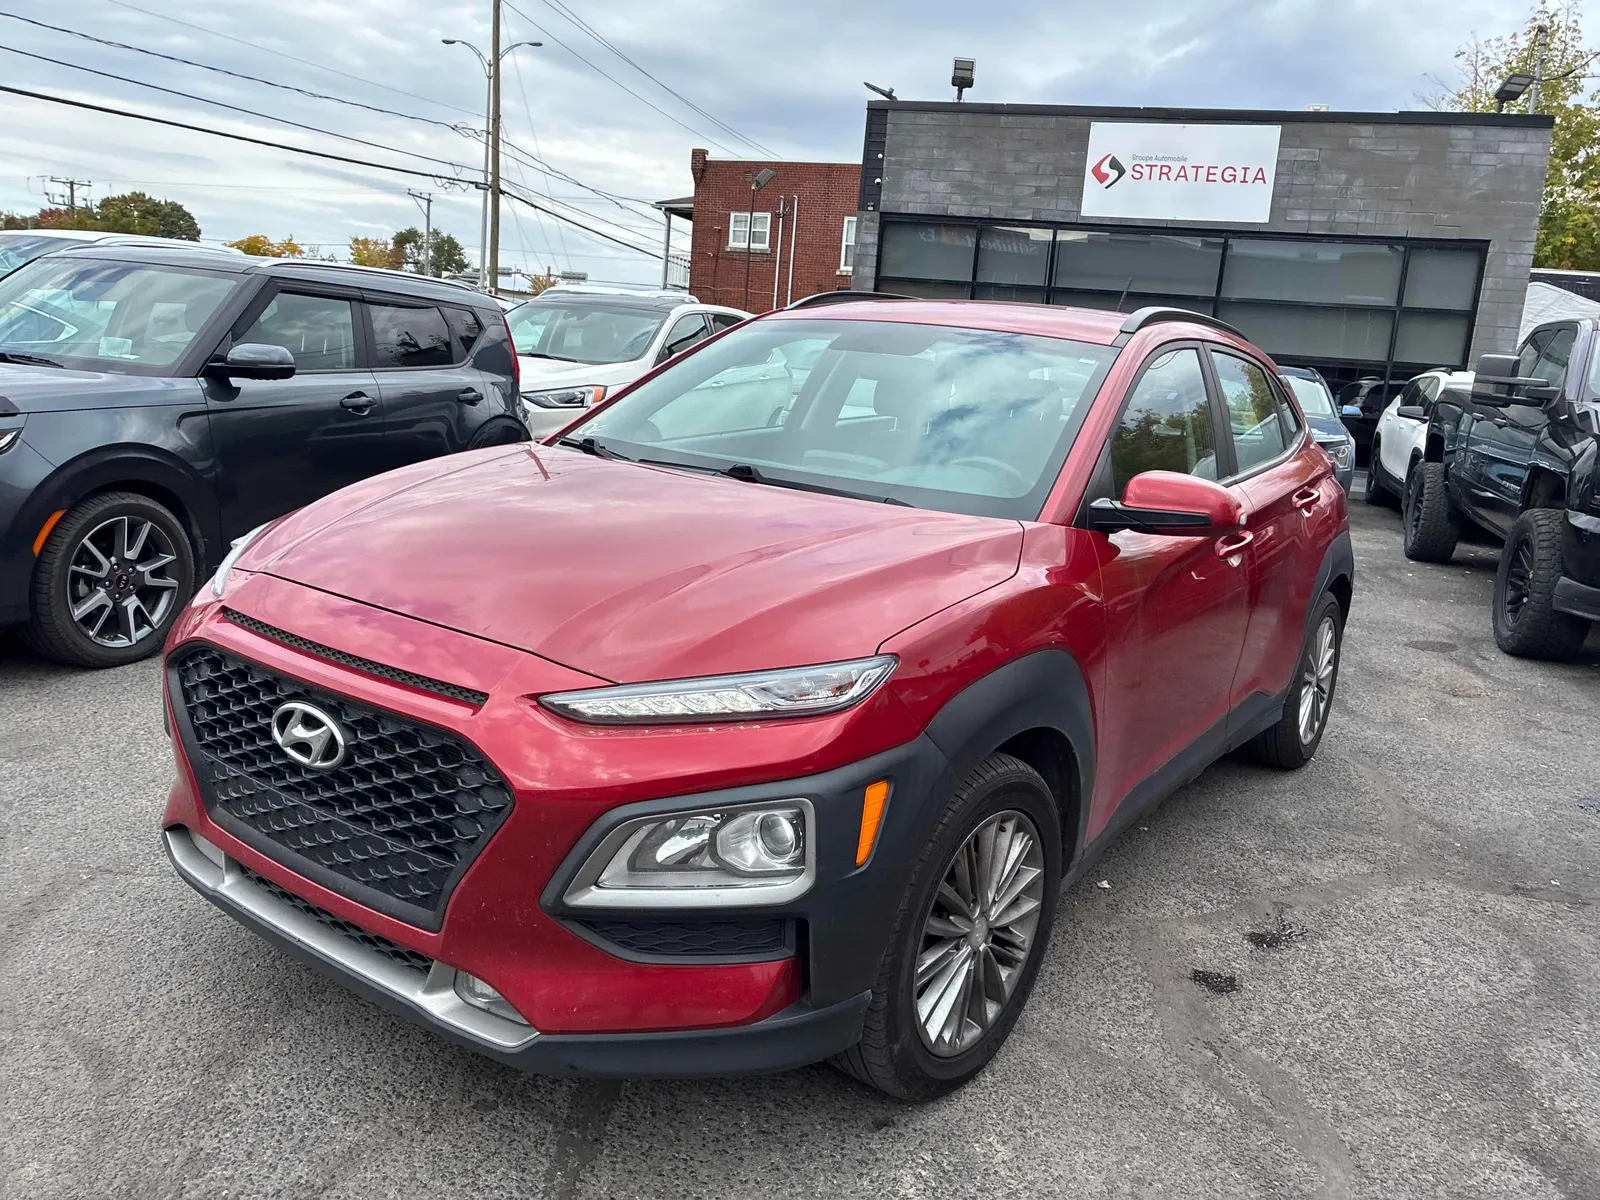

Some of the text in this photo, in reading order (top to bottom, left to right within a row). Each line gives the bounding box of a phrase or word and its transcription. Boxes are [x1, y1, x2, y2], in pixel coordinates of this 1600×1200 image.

[1131, 153, 1188, 163] Groupe Automobile
[1131, 163, 1267, 184] STRATEGIA
[119, 575, 127, 588] KIA
